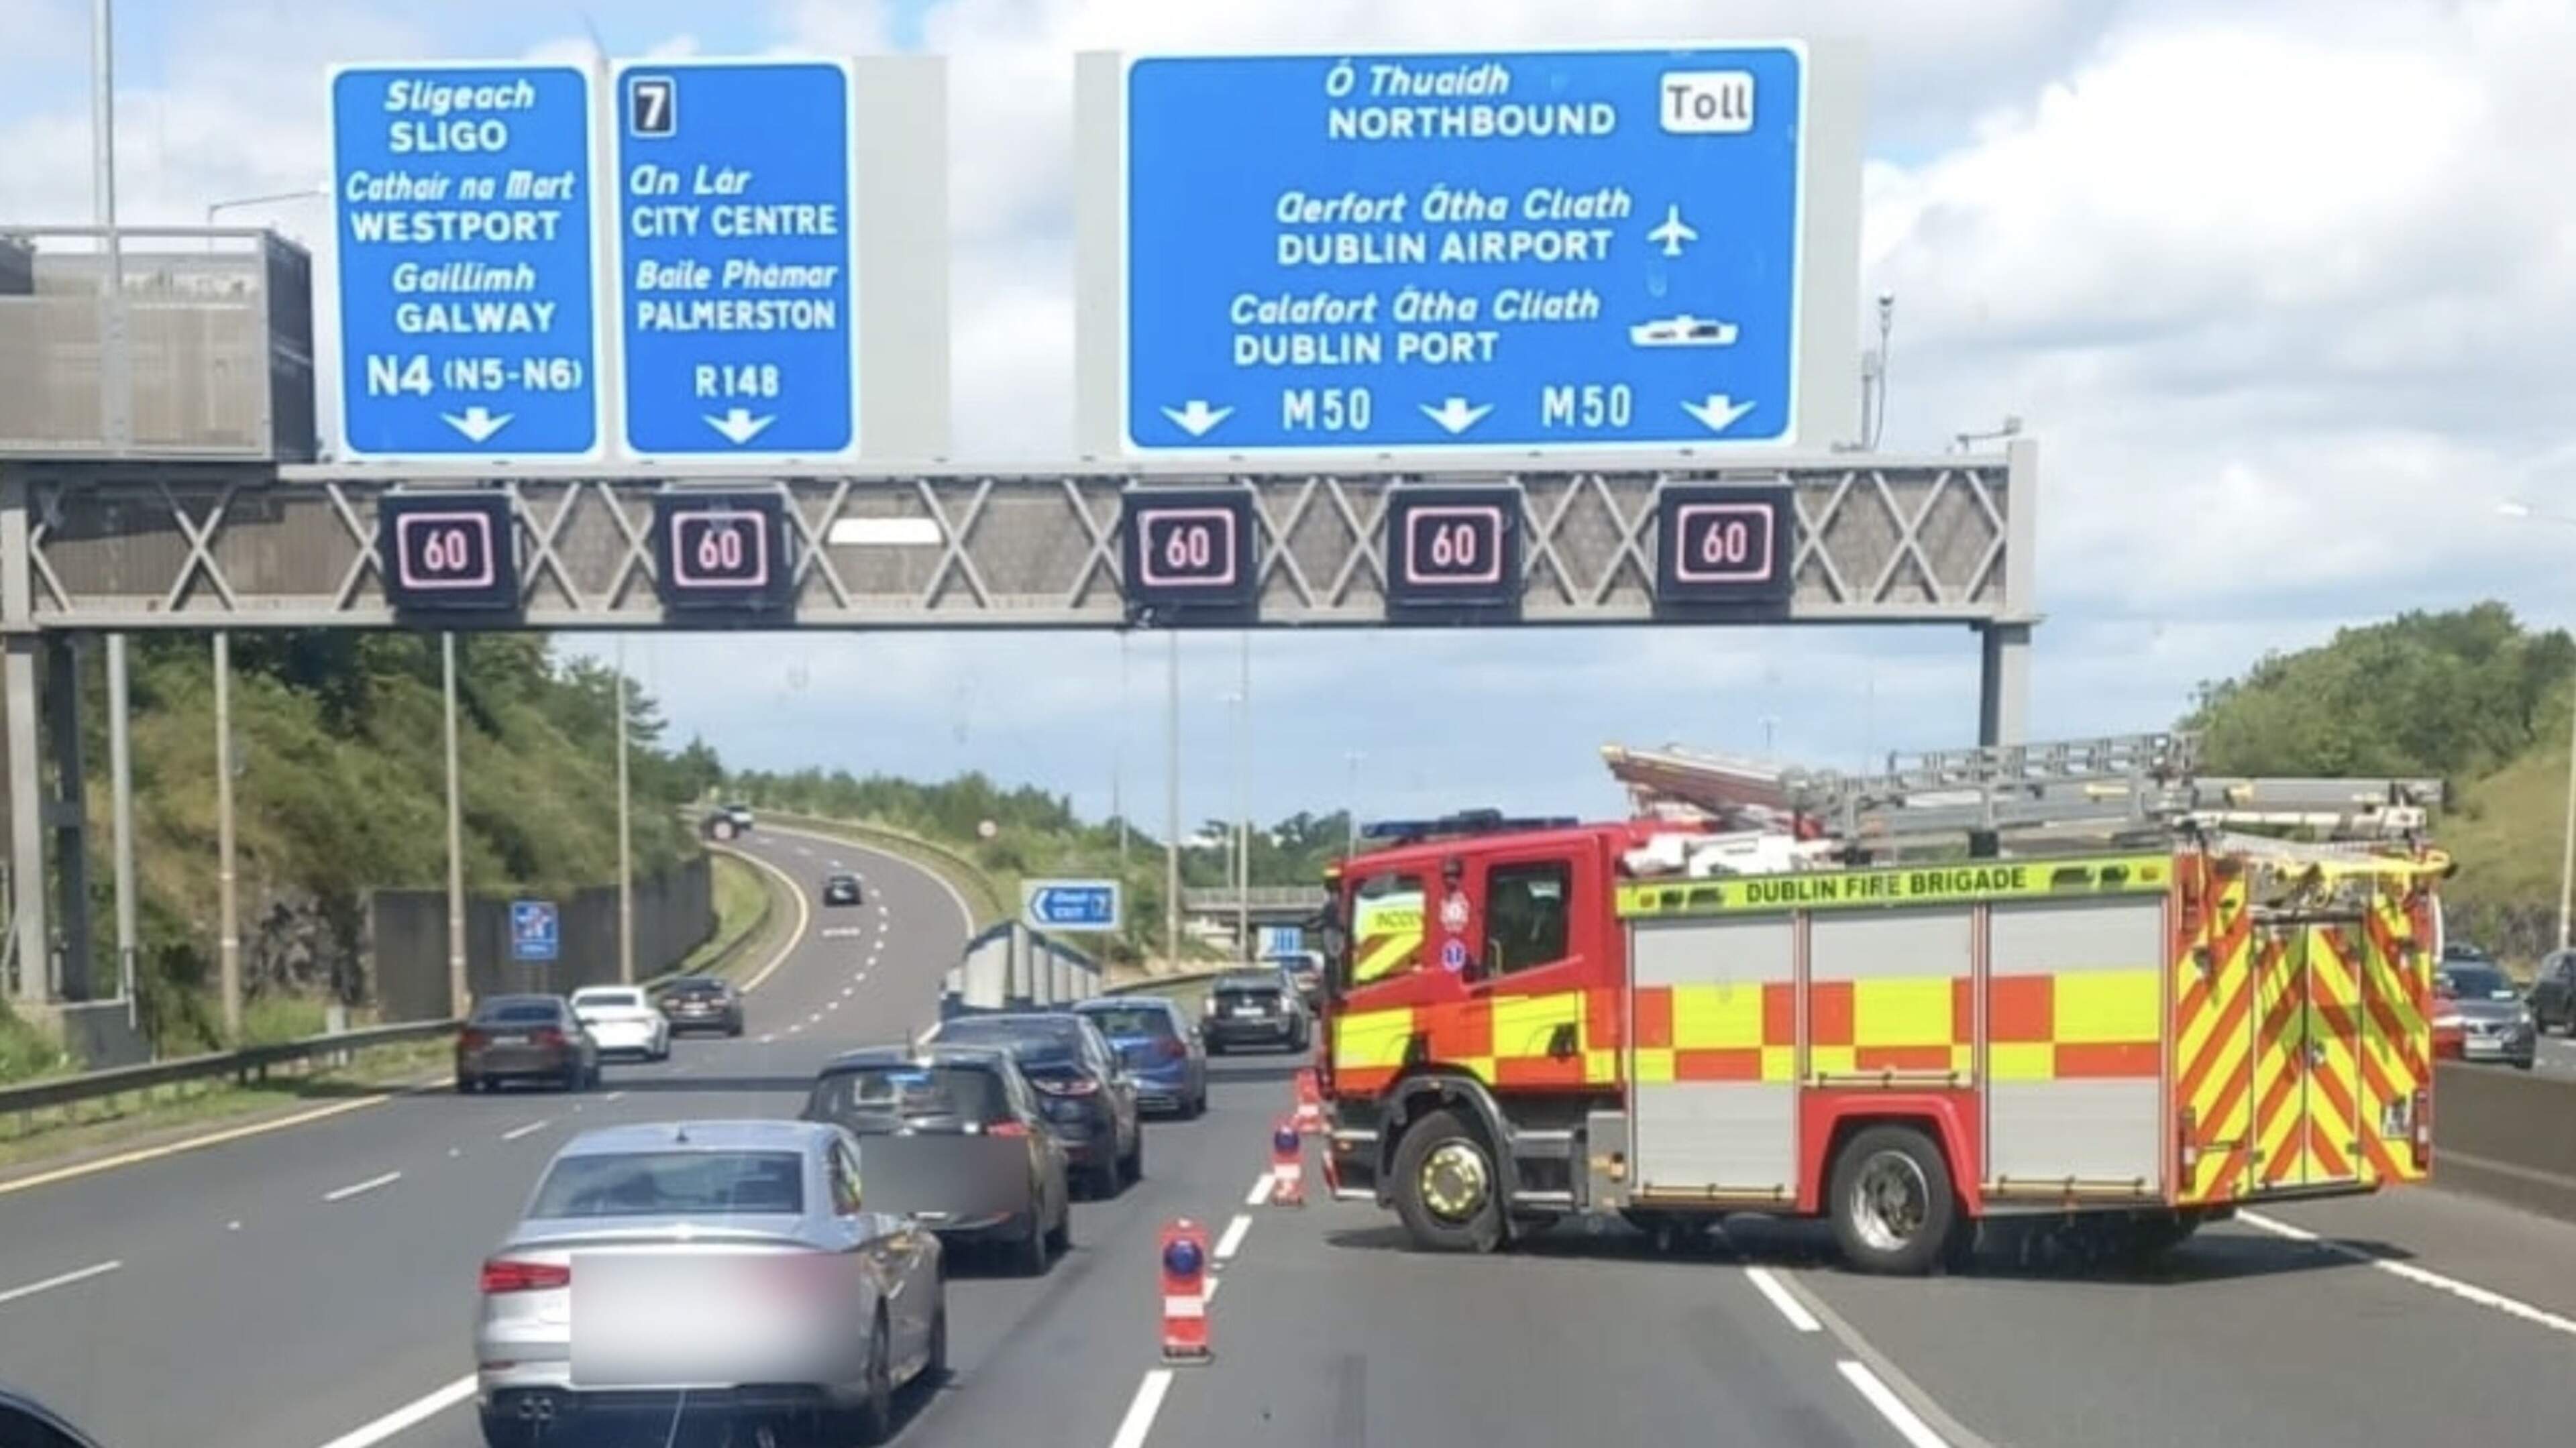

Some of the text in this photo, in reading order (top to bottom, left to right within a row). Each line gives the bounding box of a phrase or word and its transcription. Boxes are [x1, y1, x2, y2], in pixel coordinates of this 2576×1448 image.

[1327, 59, 1509, 96] Ó Thuaidh
[386, 80, 534, 115] Sligeach
[639, 87, 665, 127] 7
[1668, 86, 1746, 119] Toll
[391, 120, 506, 152] SLIGO
[1330, 104, 1615, 138] NORTHBOUND
[347, 170, 574, 201] Cathair na Mart
[631, 165, 678, 194] An
[1277, 183, 1630, 223] Aerfort Átha Cliath
[352, 211, 559, 241] WESTPORT
[633, 205, 836, 237] CITY CENTRE
[1279, 230, 1611, 264] DUBLIN AIRPORT
[394, 263, 535, 292] Gaillimh
[637, 260, 711, 289] Baile
[396, 303, 553, 332] GALWAY
[639, 300, 835, 329] PALMERSTON
[1232, 284, 1599, 324] Calafort Átha Cliath
[1235, 332, 1498, 365] DUBLIN PORT
[368, 355, 582, 395] N4 (N5-N6)
[696, 366, 777, 396] R148
[1284, 389, 1370, 430] M50
[1544, 386, 1630, 427] M50
[424, 530, 467, 570] 60
[698, 531, 741, 569] 60
[1167, 526, 1210, 566] 60
[1433, 524, 1475, 565] 60
[1704, 522, 1746, 562] 60
[1746, 867, 2027, 903] DUBLIN FIRE BRIGADE
